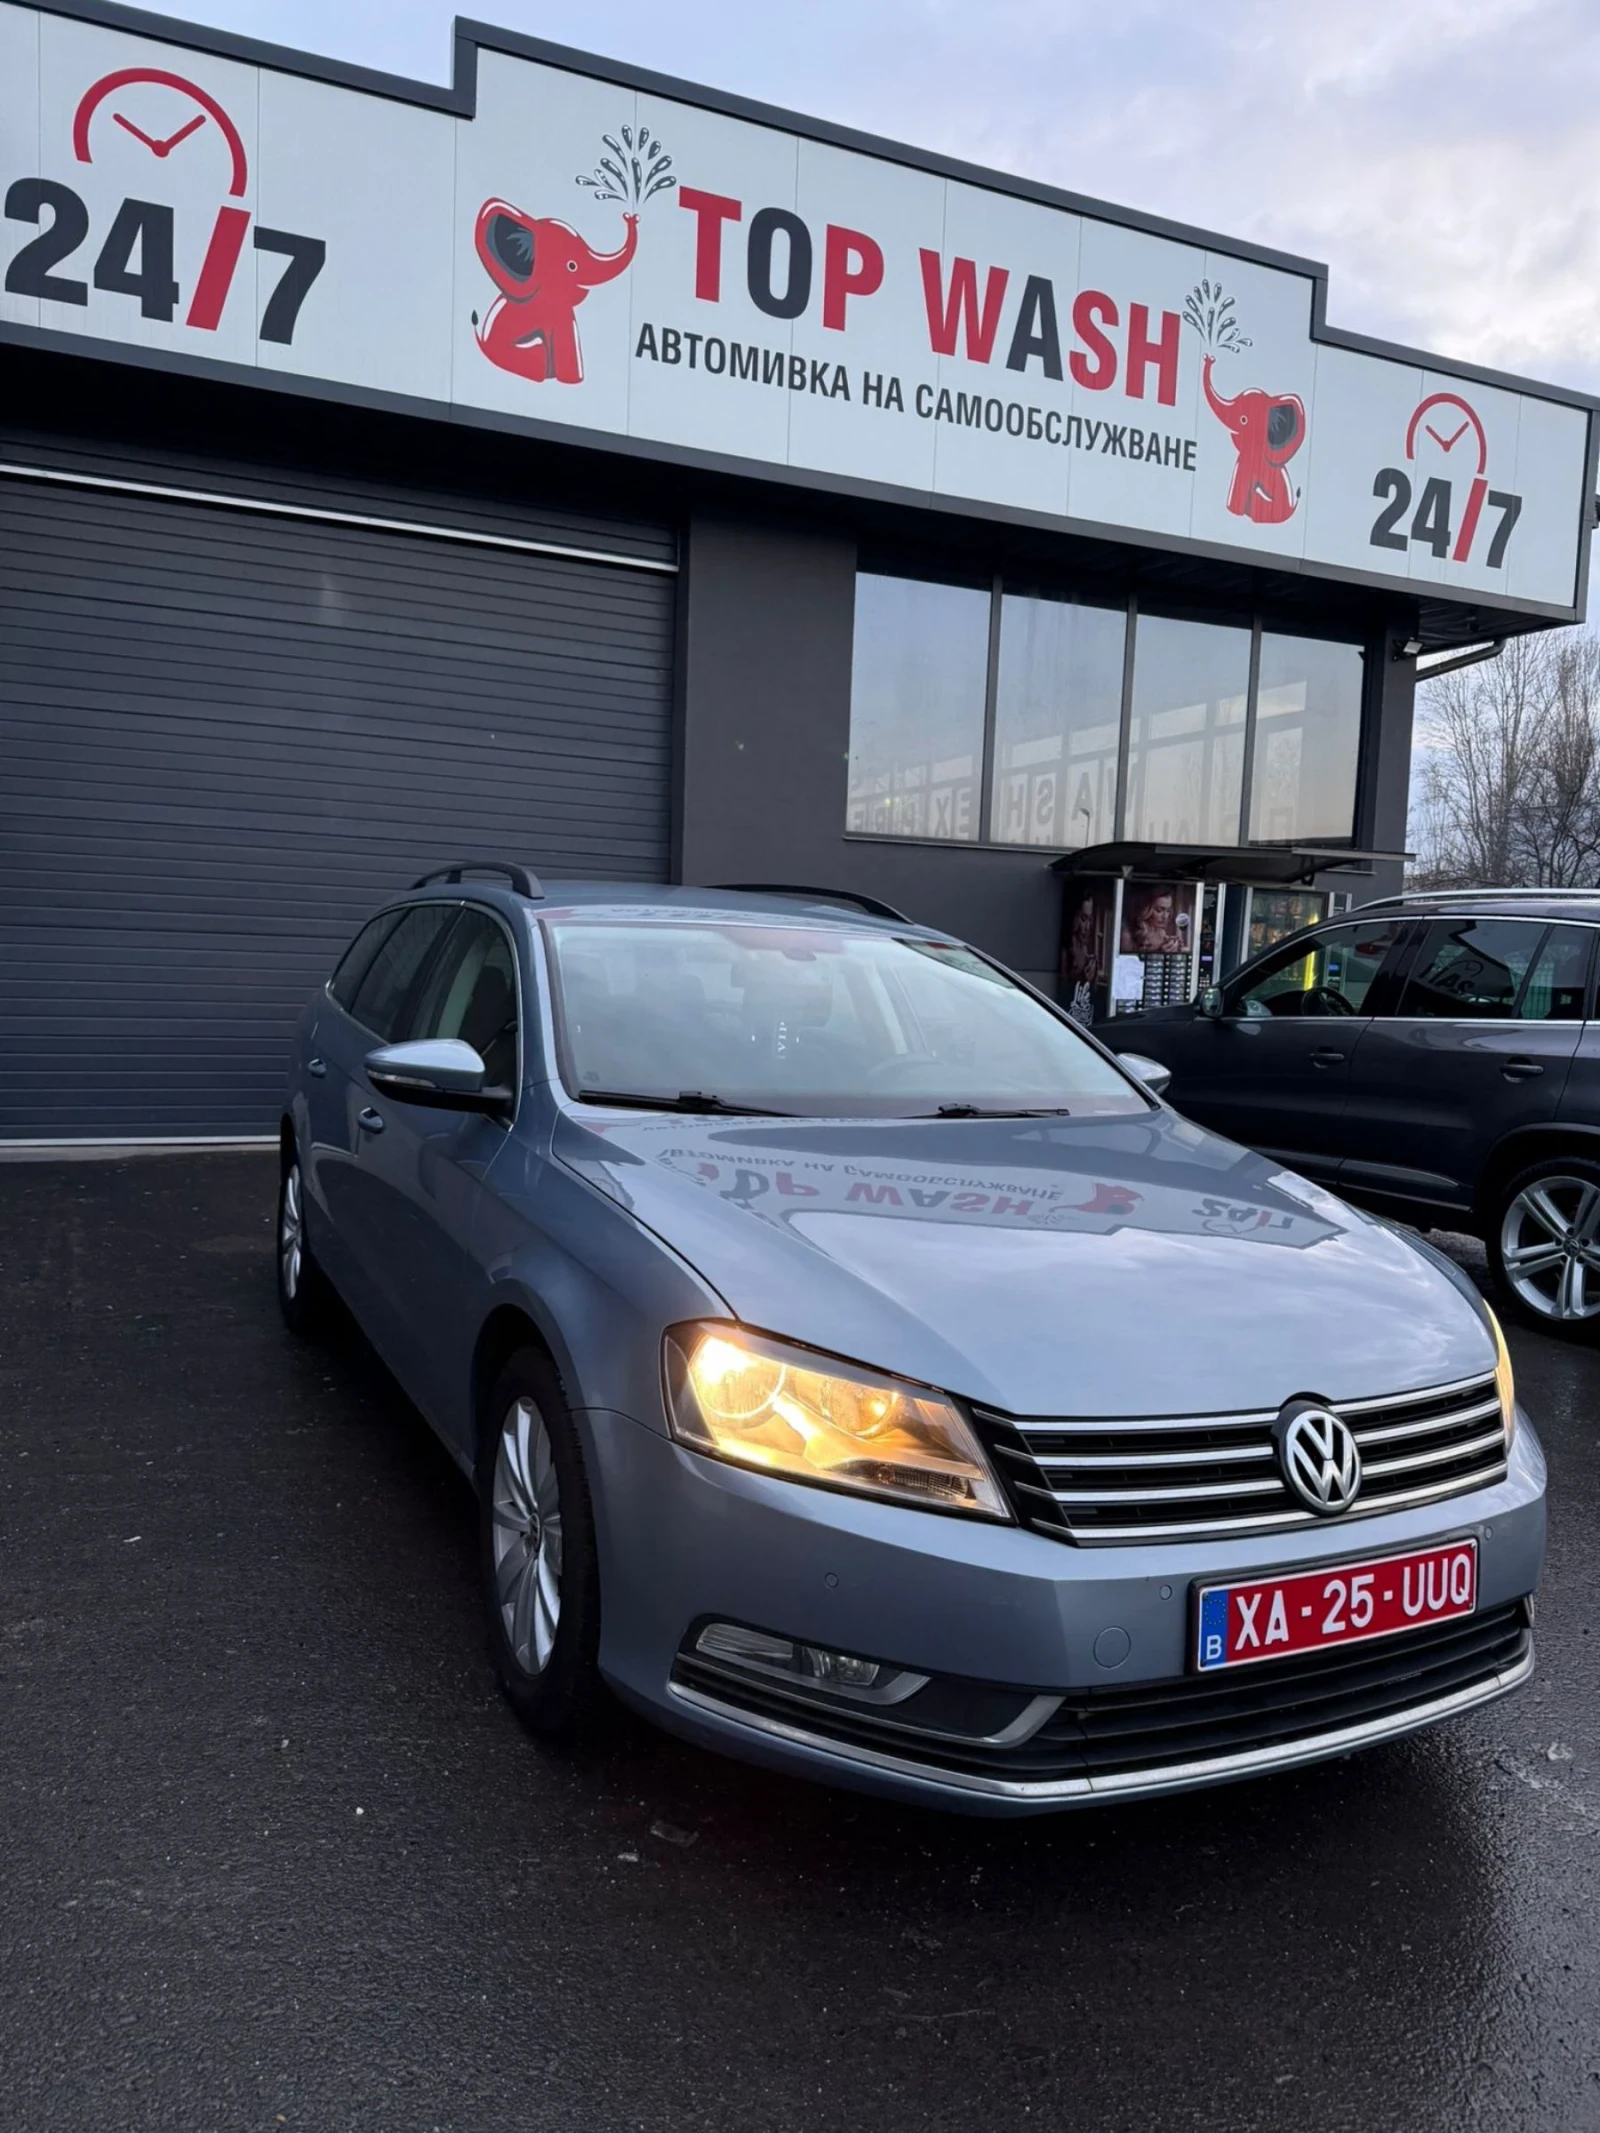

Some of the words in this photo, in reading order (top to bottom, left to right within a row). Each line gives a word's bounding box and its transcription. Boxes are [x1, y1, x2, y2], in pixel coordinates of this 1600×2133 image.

[3, 177, 327, 346] 24/7
[678, 185, 885, 332] TOP
[919, 247, 1181, 407] WASH
[635, 322, 851, 402] АВТОМИВКА
[862, 371, 905, 413] НА
[915, 383, 1198, 473] САМООБСЛУЖВАНЕ
[1369, 467, 1523, 569] 24/7
[1205, 1634, 1222, 1660] B
